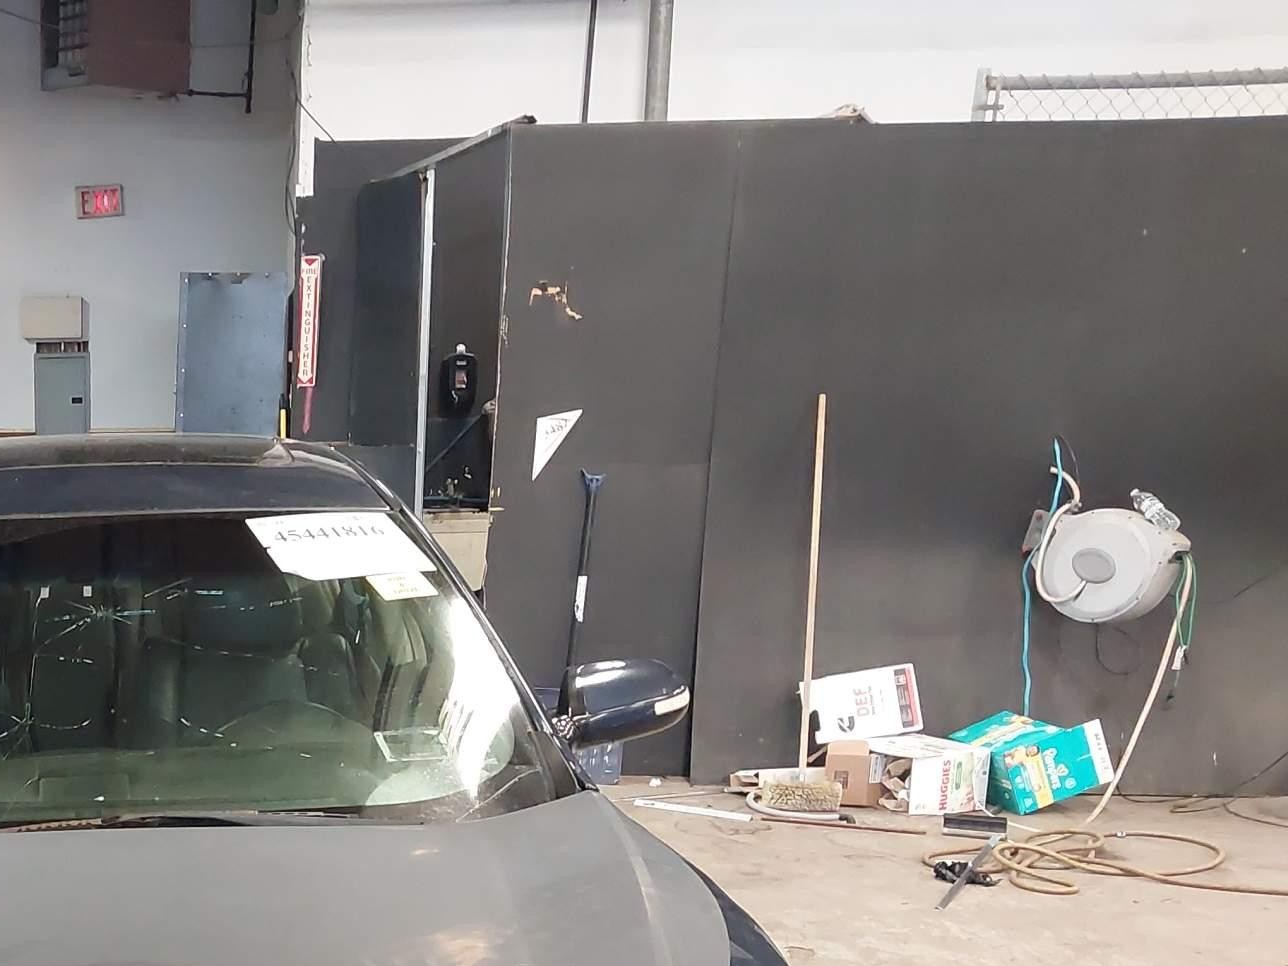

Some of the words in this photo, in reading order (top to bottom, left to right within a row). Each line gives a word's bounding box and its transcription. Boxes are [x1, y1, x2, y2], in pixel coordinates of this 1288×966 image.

[81, 188, 119, 215] EXIT
[302, 276, 313, 377] EXTINGUISHER
[274, 525, 385, 543] 45441816
[852, 688, 870, 718] DEF
[938, 759, 952, 811] HUGGIES
